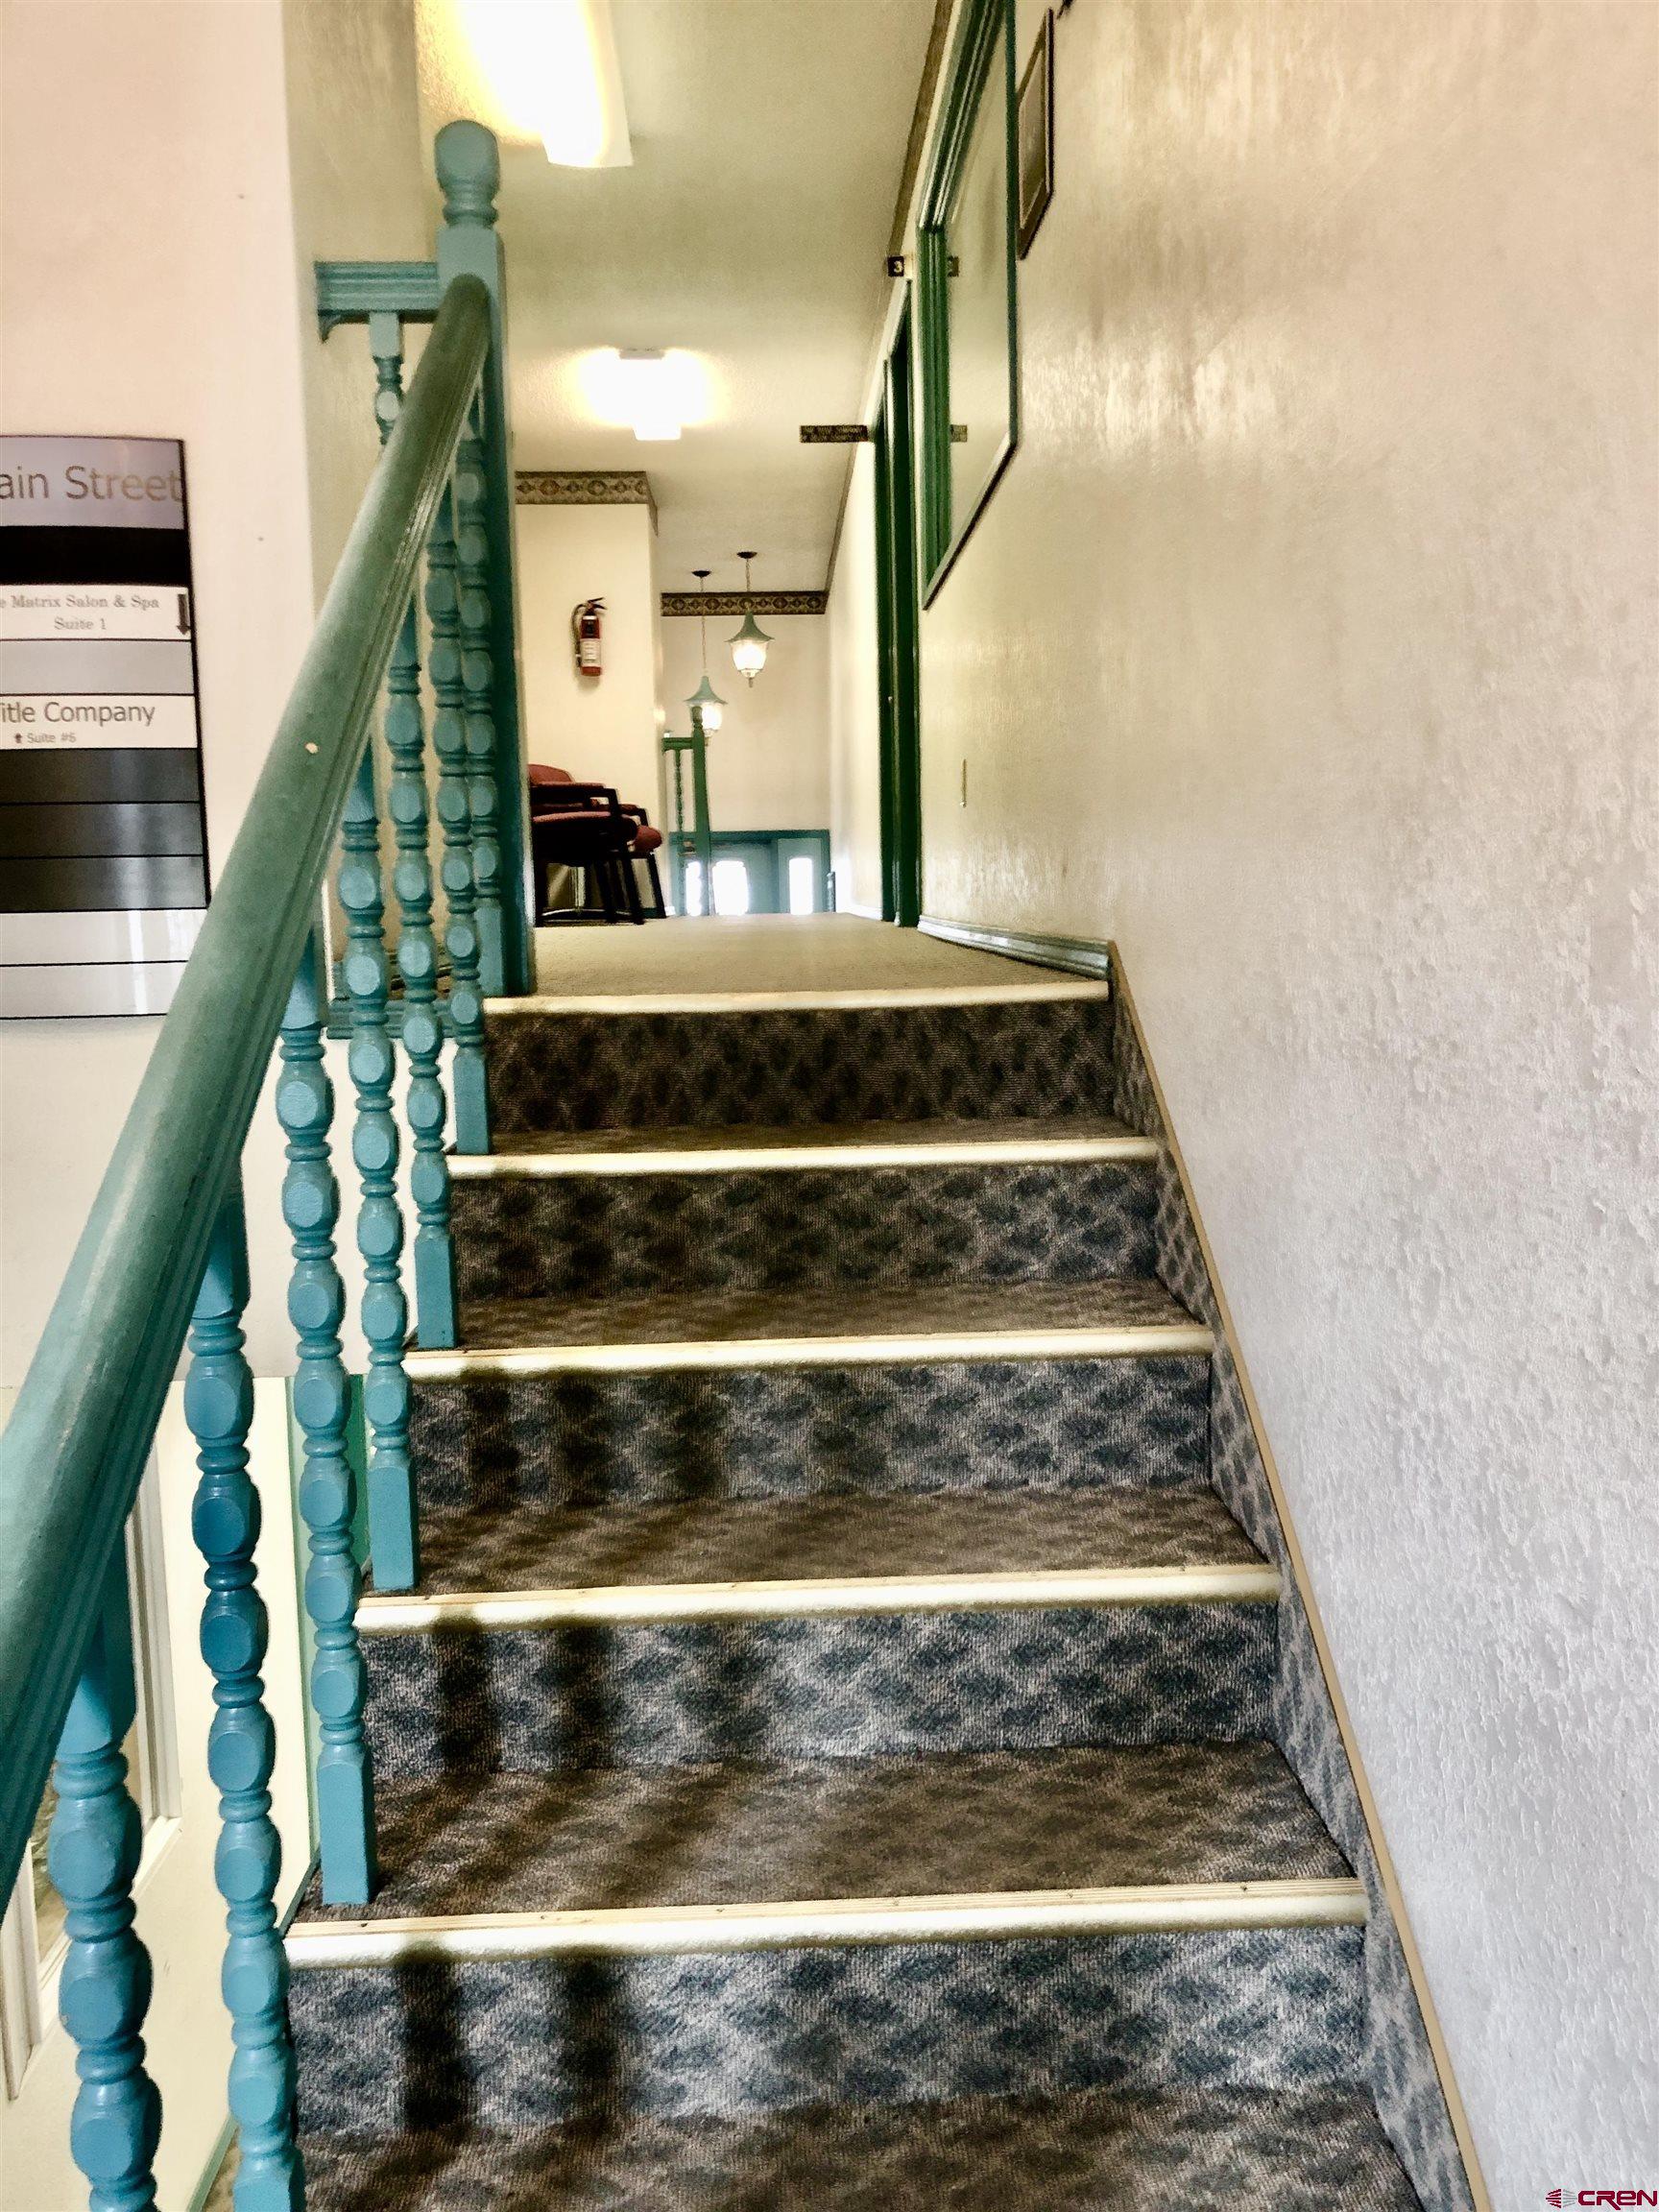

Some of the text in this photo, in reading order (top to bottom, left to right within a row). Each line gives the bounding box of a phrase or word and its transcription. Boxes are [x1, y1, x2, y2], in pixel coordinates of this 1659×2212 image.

[65, 465, 182, 502] Street
[11, 594, 61, 609] Matrix
[65, 593, 108, 609] Salon
[112, 594, 126, 608] &
[131, 594, 159, 612] Spa
[54, 616, 107, 630] Suite 1
[44, 702, 156, 727] Company
[27, 733, 56, 743] Suite
